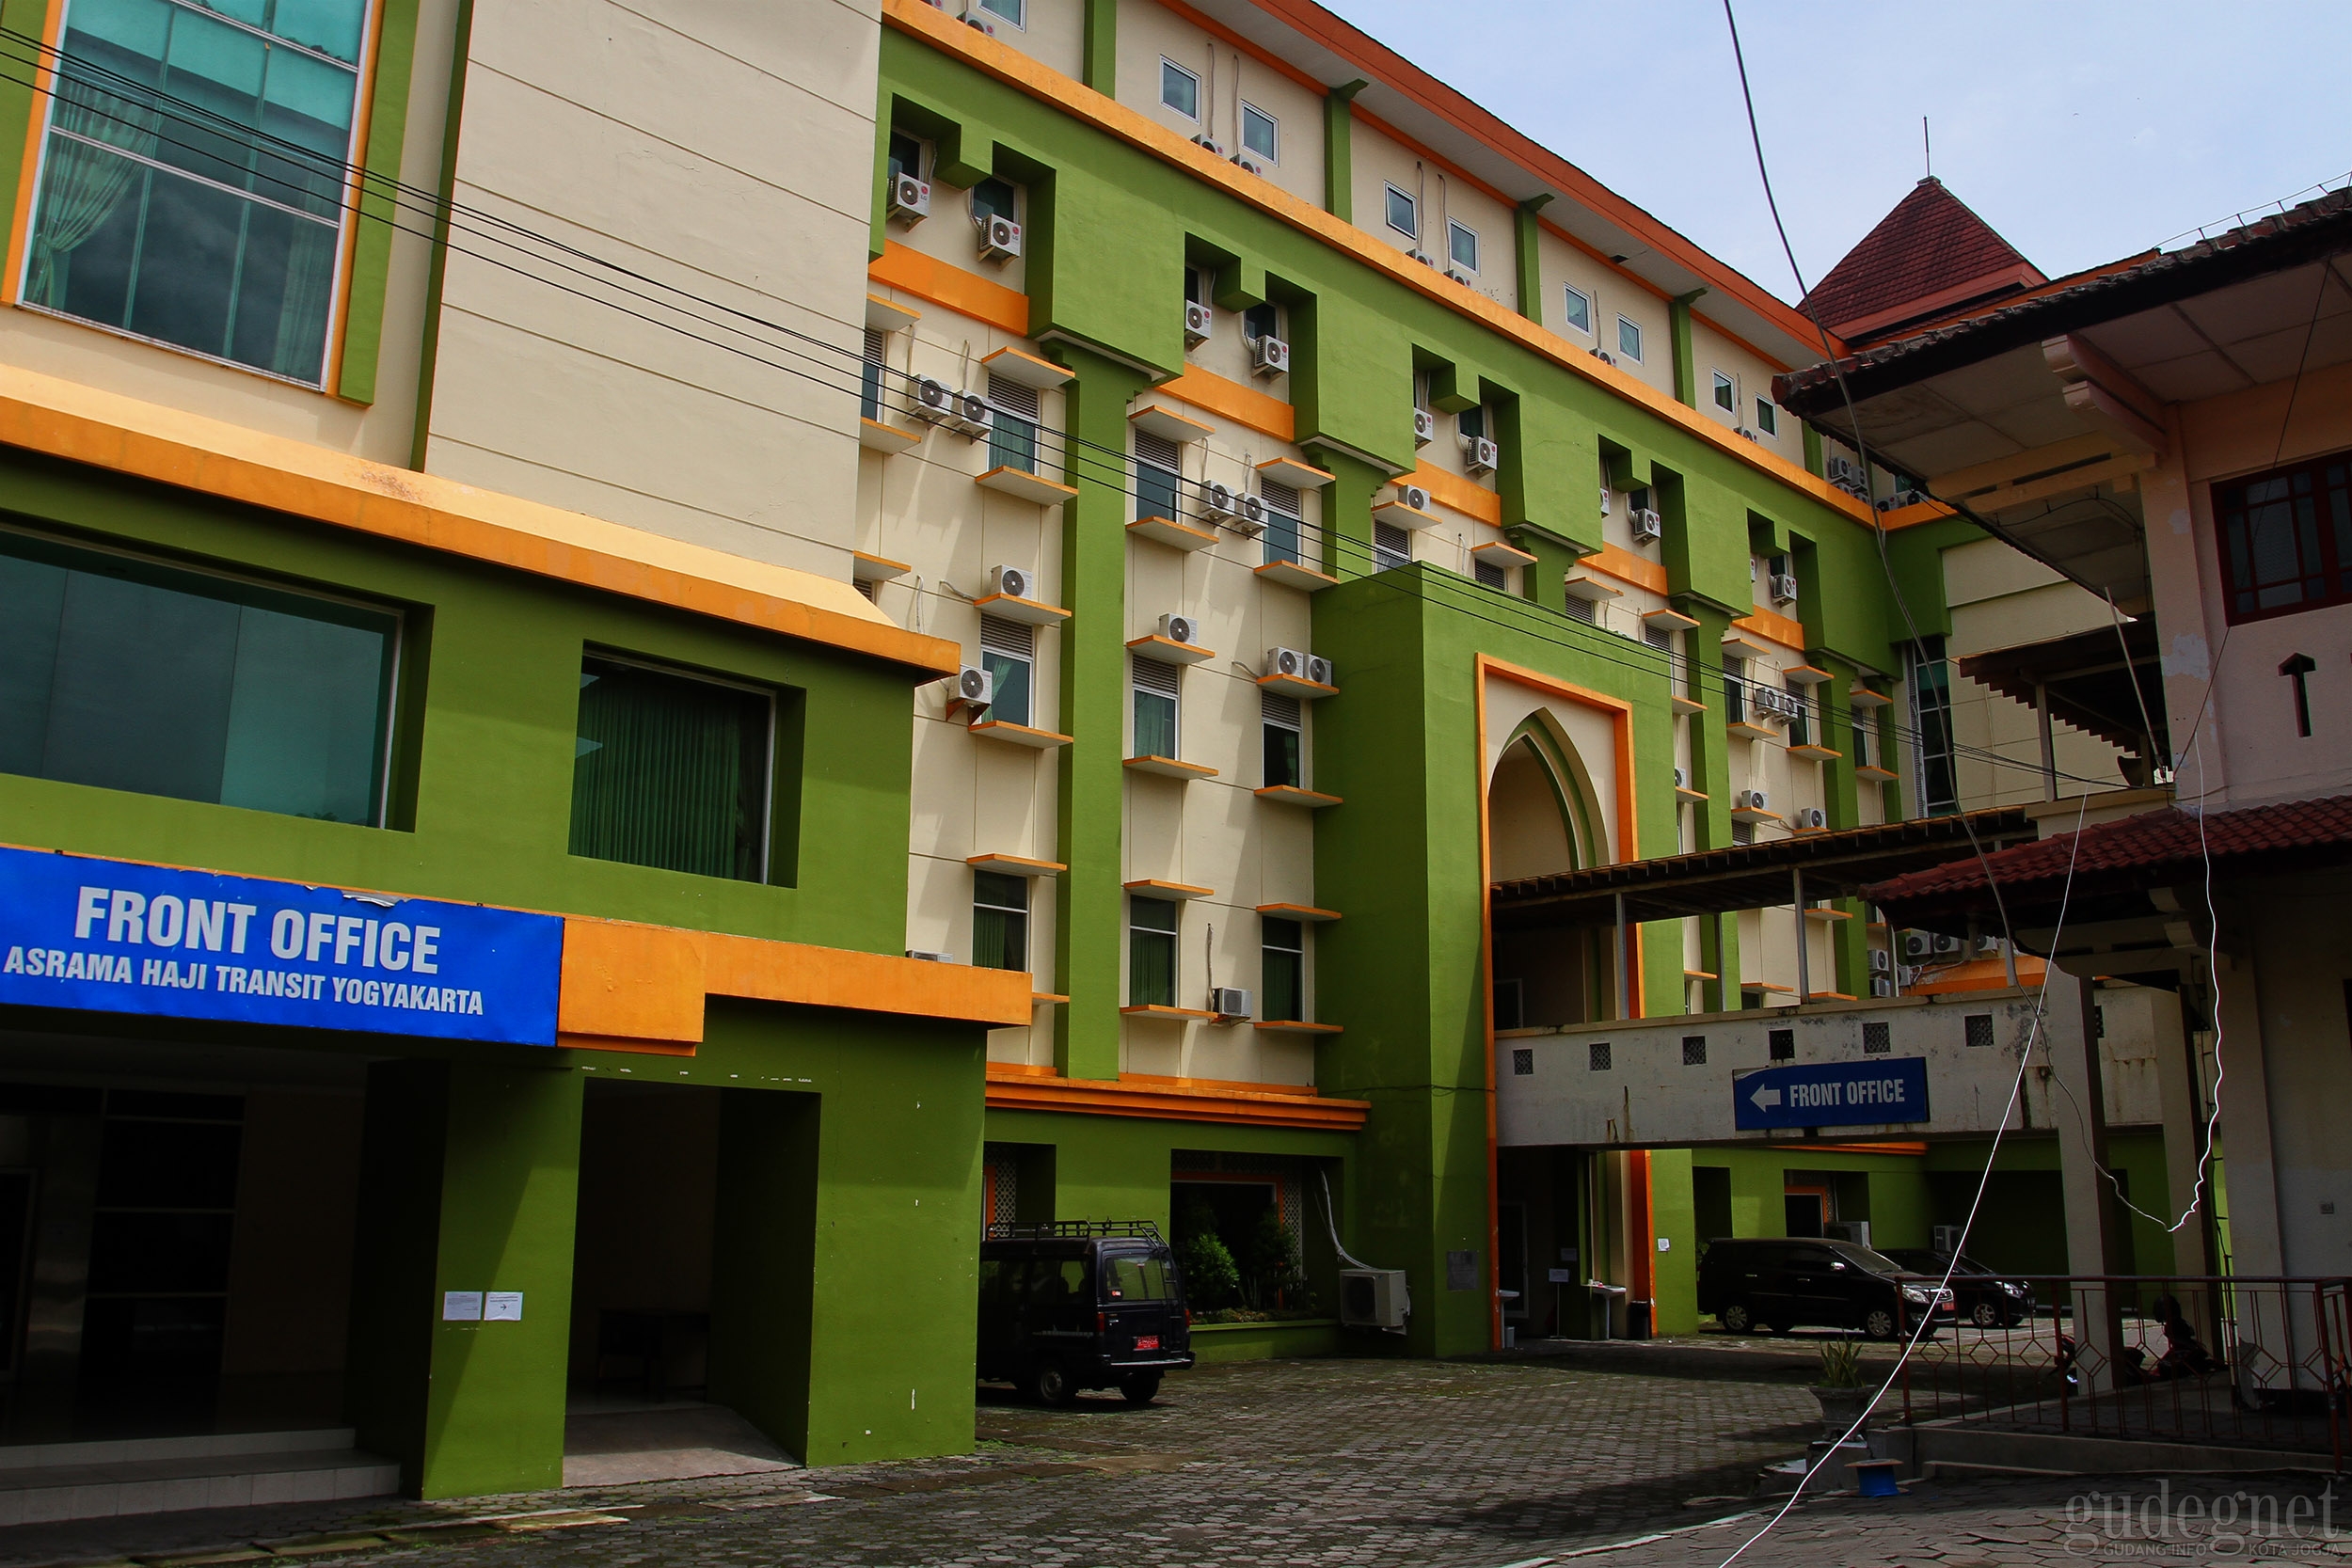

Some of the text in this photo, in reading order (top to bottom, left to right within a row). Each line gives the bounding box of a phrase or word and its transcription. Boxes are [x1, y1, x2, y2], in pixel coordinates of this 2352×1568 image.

[73, 885, 441, 975] FRONT OFFICE
[3, 945, 485, 1016] ASRAMA HAJI TRANSIT YOGYAKARTA
[1788, 1079, 1905, 1108] FRONT OFFICE
